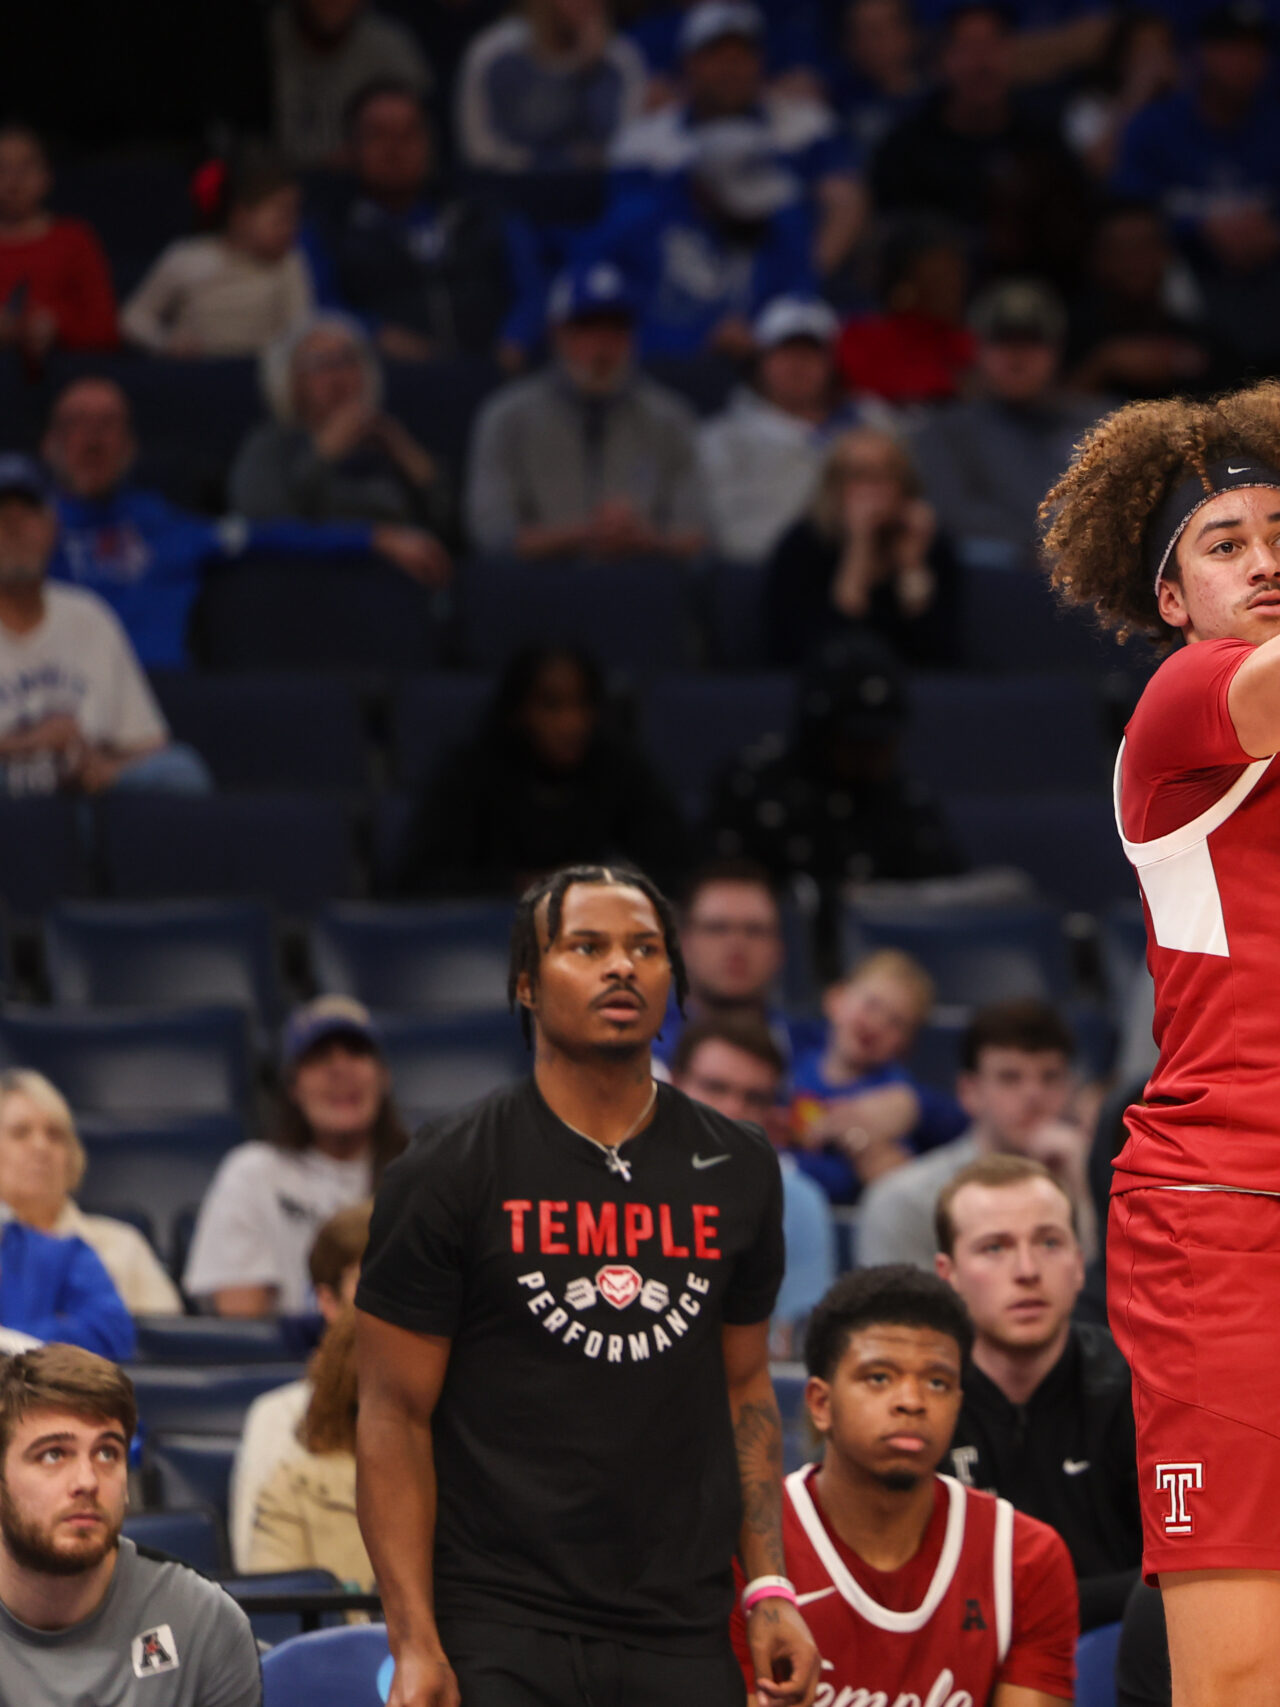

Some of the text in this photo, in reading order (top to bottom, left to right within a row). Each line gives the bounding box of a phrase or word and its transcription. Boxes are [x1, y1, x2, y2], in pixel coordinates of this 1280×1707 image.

[502, 1200, 722, 1260] TEMPLE
[517, 1270, 710, 1363] PERFORMANCE
[1155, 1462, 1203, 1533] T
